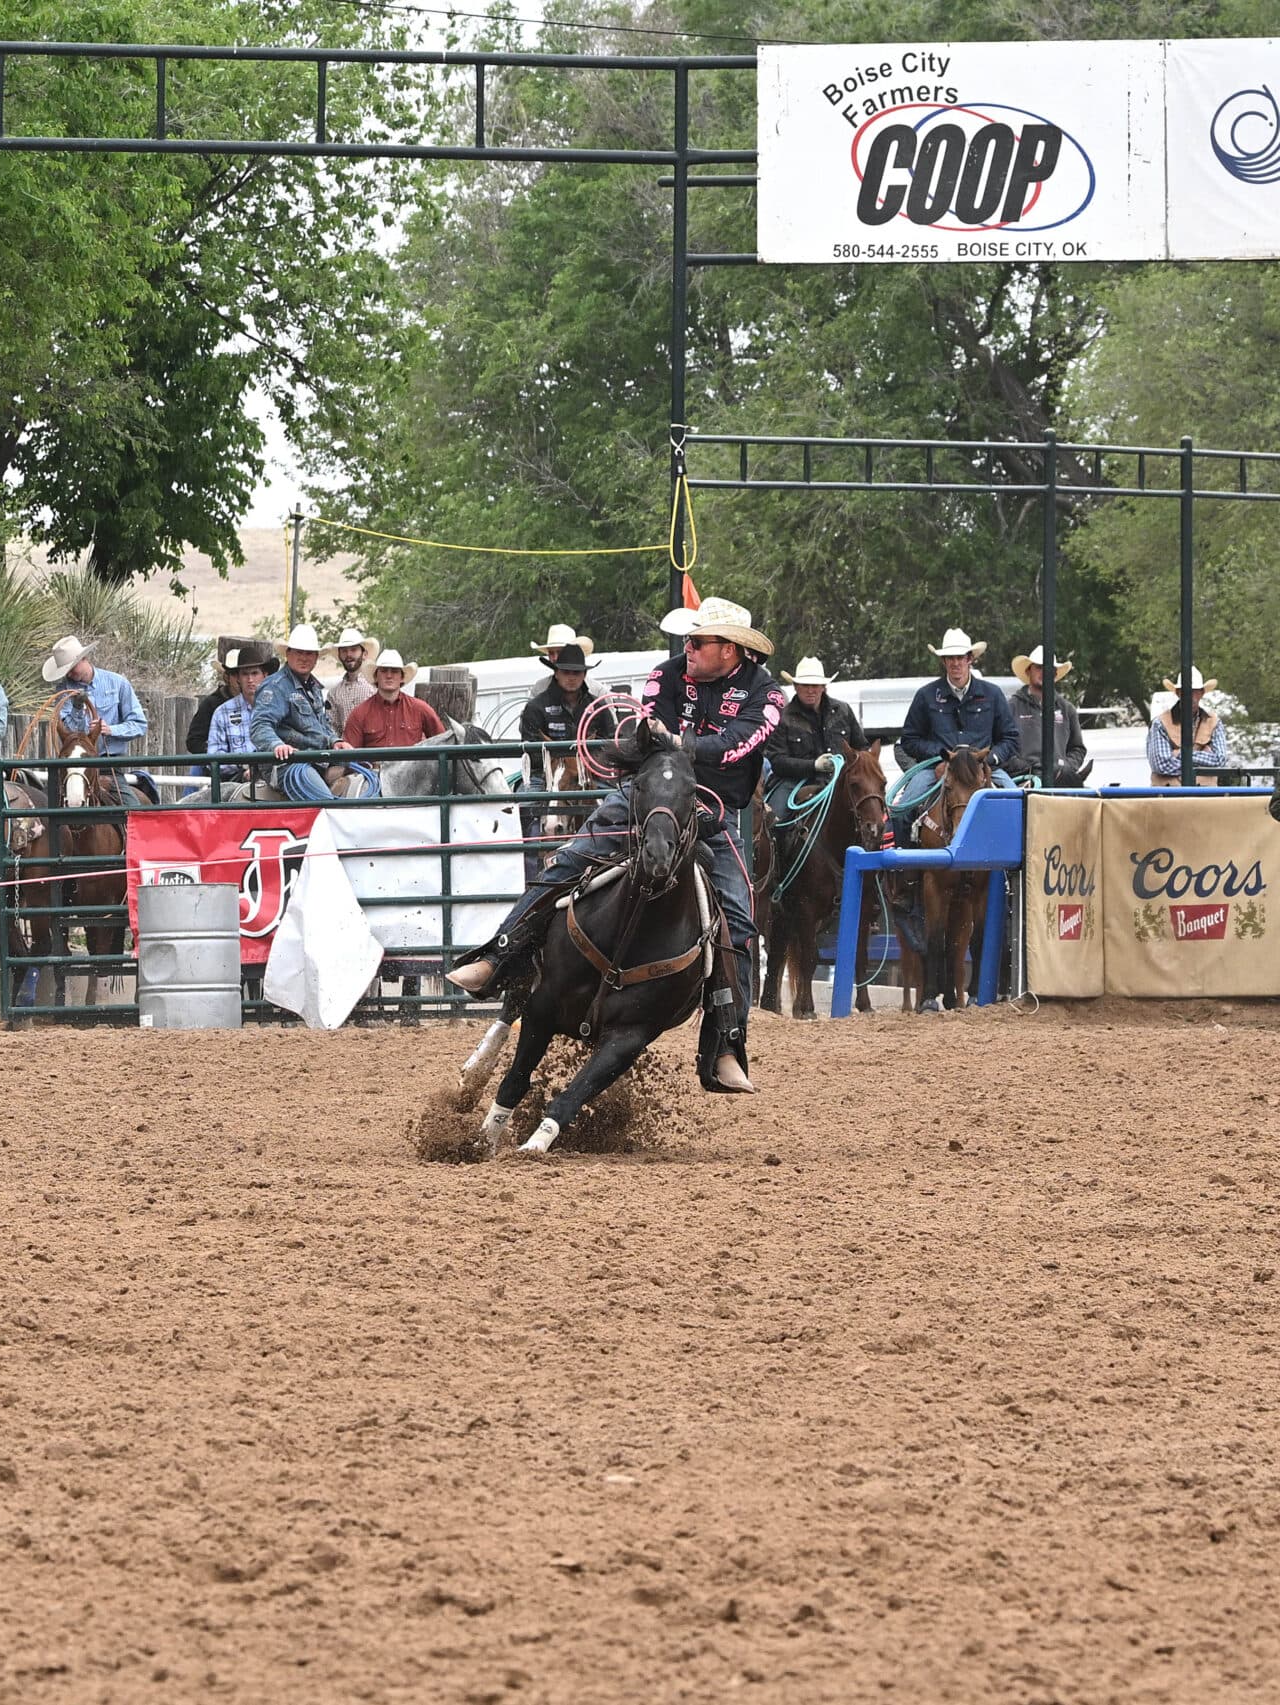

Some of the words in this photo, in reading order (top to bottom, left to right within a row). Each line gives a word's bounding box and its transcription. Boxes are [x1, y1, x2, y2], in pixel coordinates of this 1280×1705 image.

[822, 62, 893, 106] Boise
[901, 51, 951, 78] City
[841, 85, 959, 129] Farmers
[856, 122, 1063, 226] COOP
[832, 244, 939, 259] 580-544-2555
[957, 242, 1010, 257] BOISE
[1015, 242, 1057, 259] CITY,
[1062, 242, 1088, 256] OK
[1043, 844, 1096, 897] Coors
[1130, 847, 1267, 899] Coors
[1176, 907, 1225, 938] Banquet
